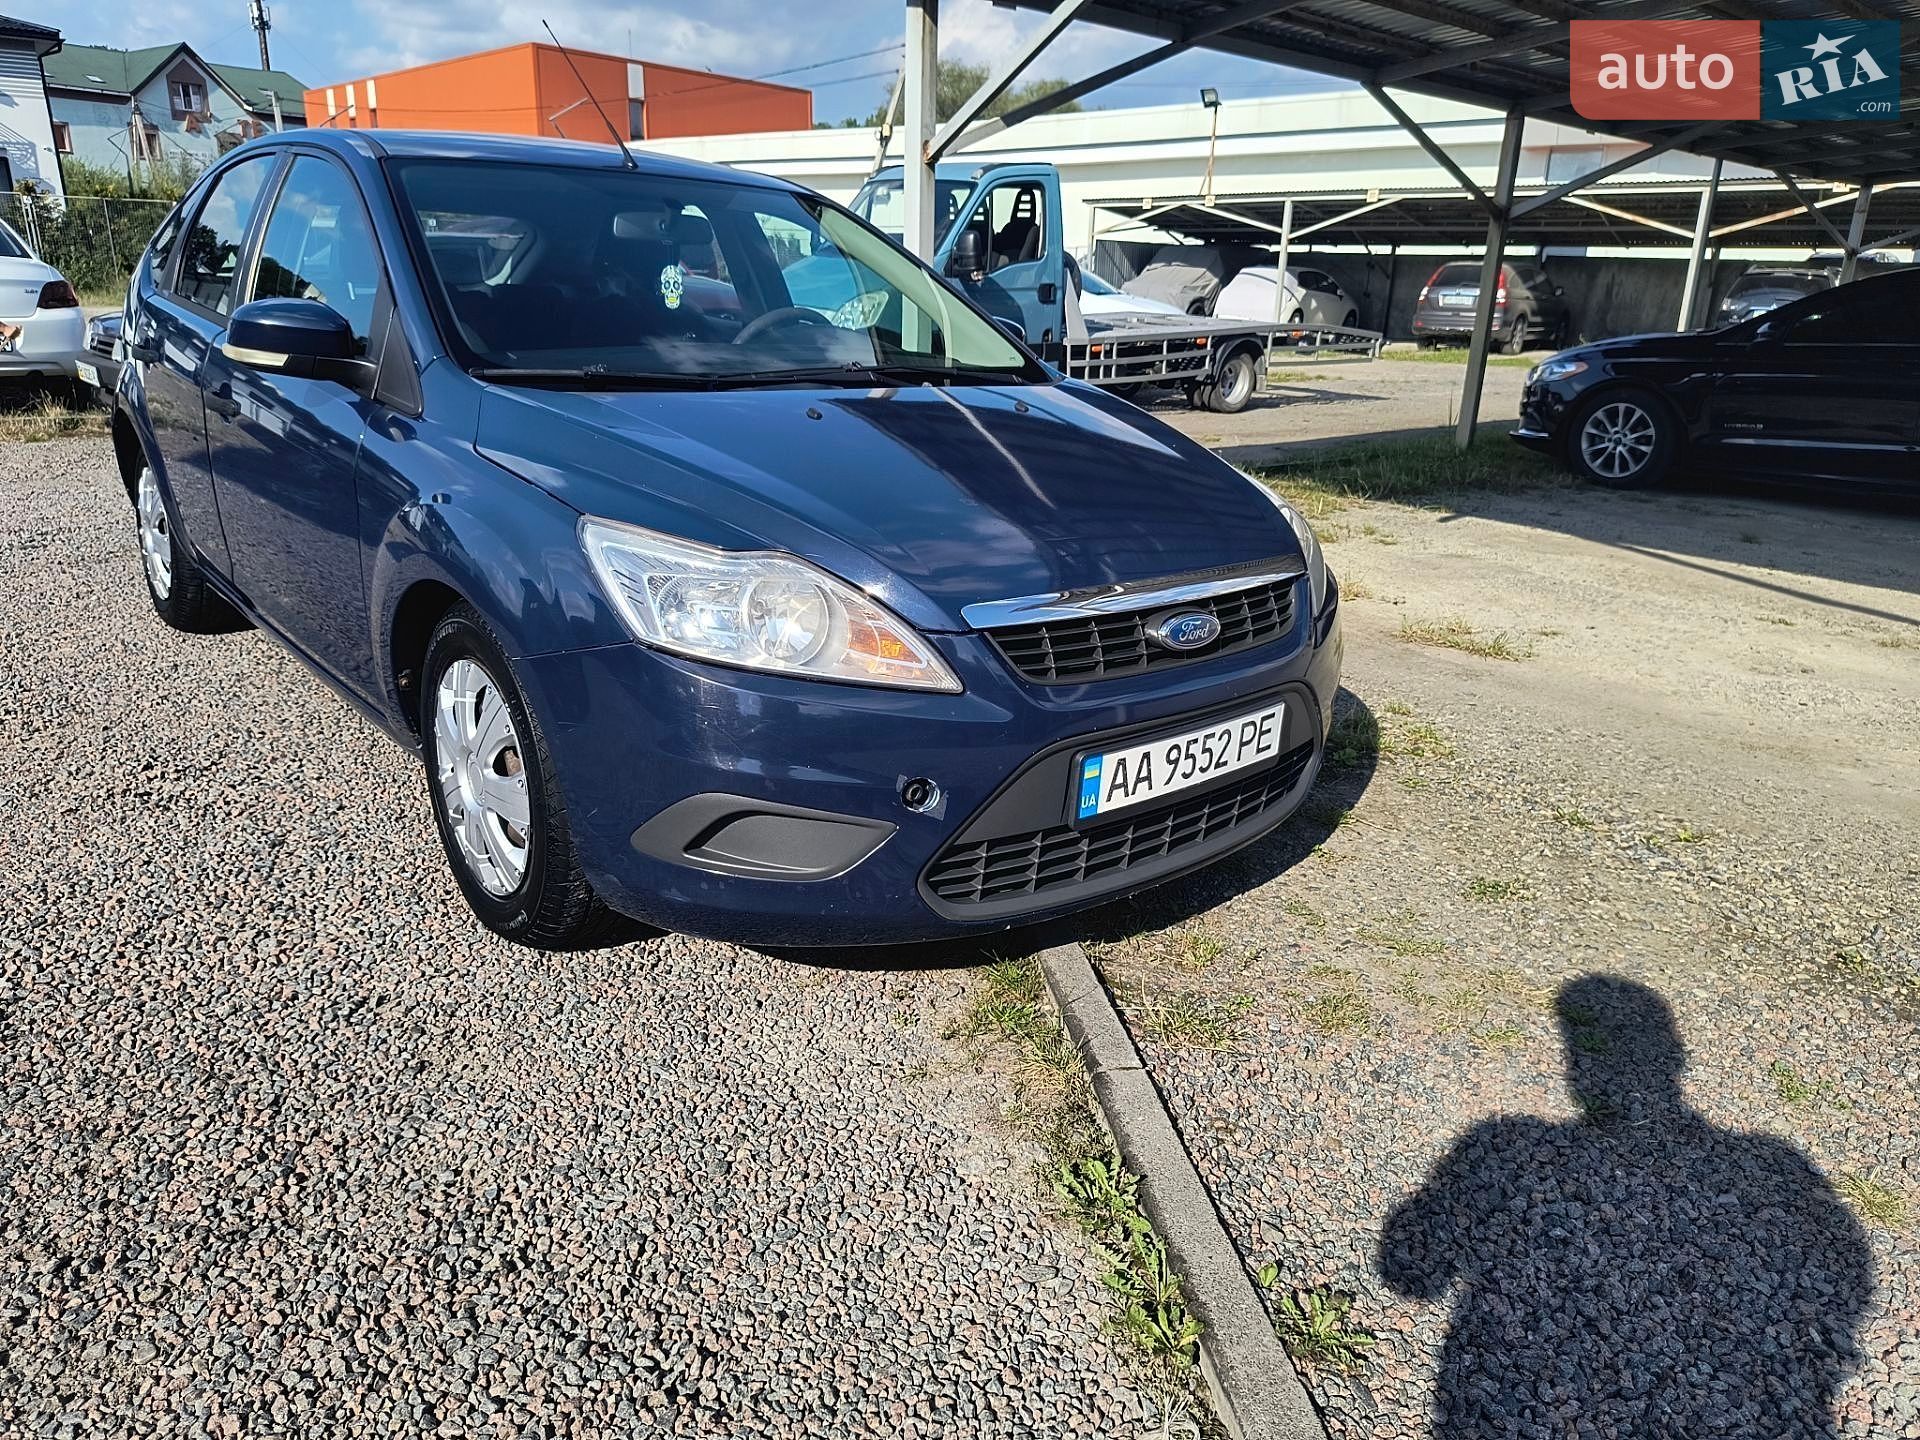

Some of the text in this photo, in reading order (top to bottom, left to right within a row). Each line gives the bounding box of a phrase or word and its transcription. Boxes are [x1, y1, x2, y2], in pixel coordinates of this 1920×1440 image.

[1179, 620, 1210, 641] Ford
[1106, 712, 1276, 803] AA 9552 PE
[1081, 794, 1097, 809] UA
